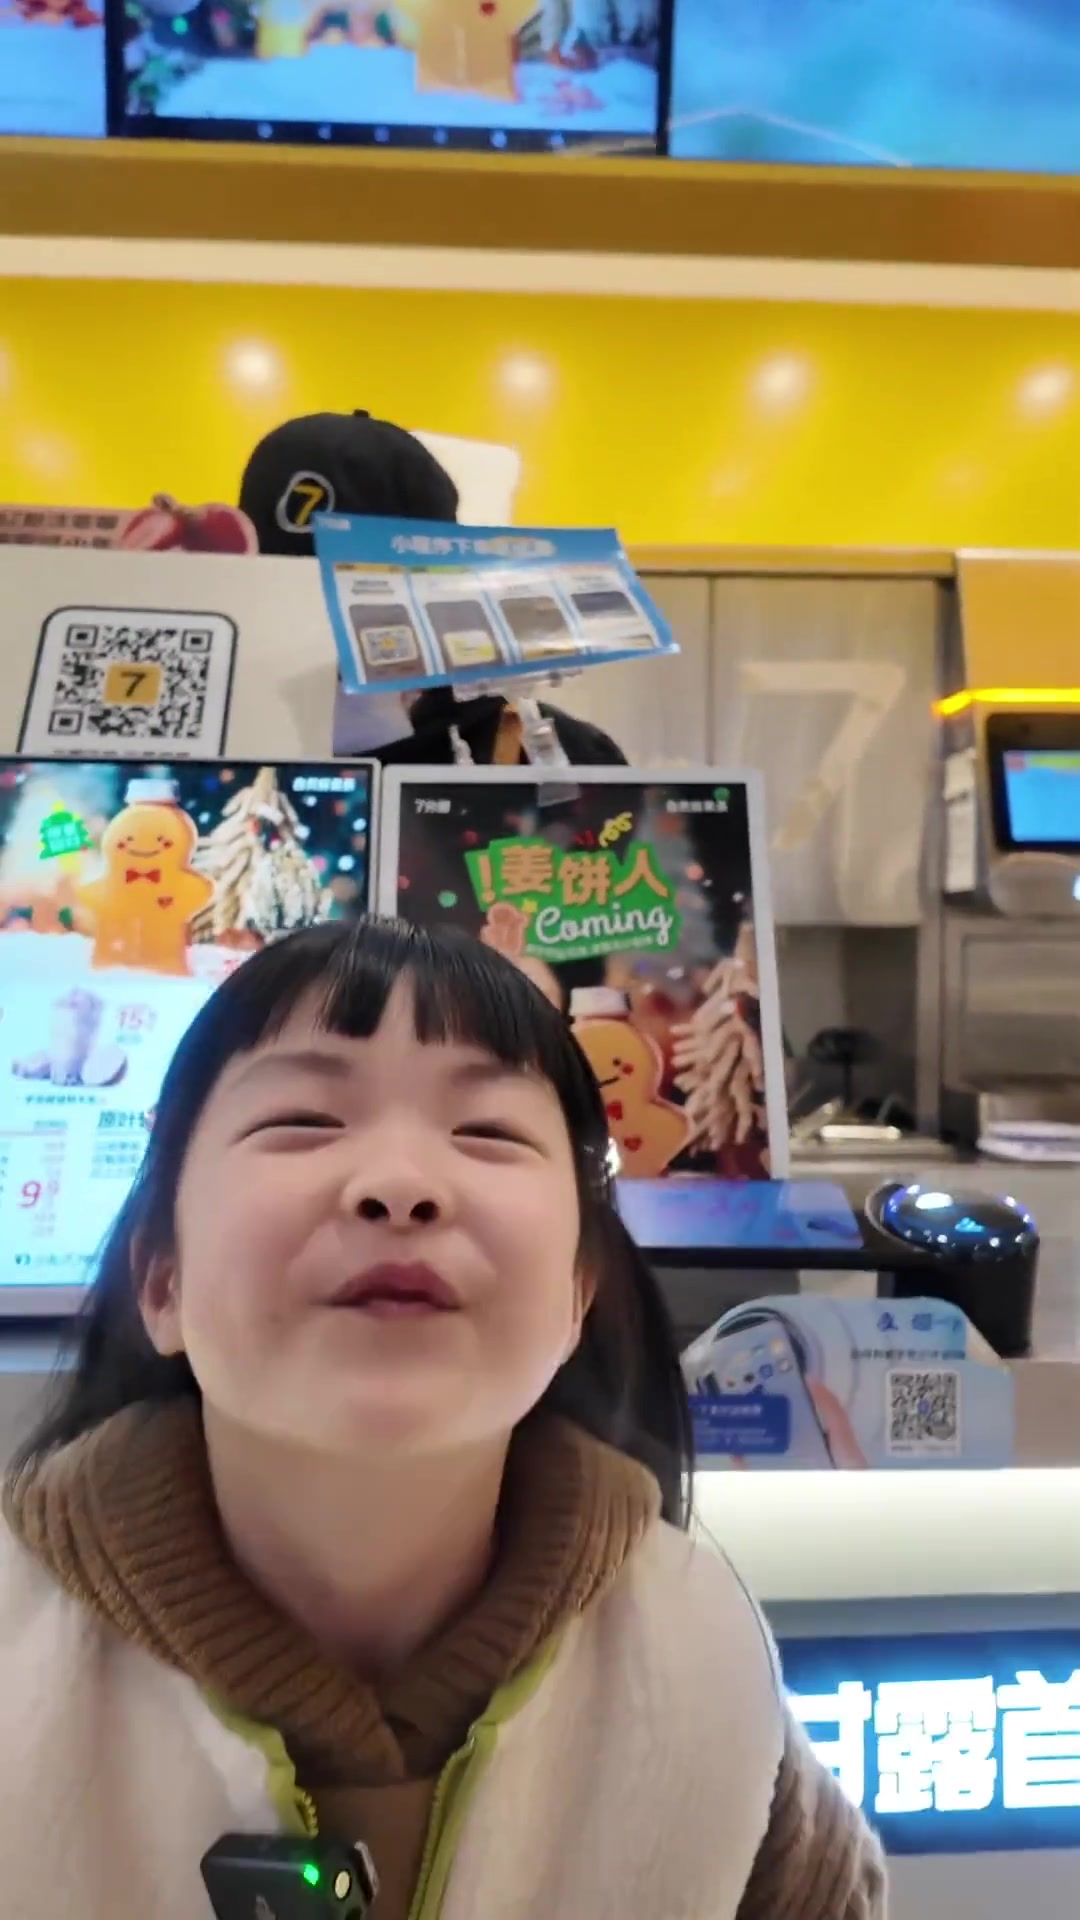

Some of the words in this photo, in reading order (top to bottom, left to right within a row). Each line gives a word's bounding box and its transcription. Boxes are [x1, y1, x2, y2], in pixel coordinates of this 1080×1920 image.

[290, 484, 324, 526] 7
[119, 671, 147, 698] 7
[535, 902, 673, 947] Coming
[20, 1181, 41, 1208] 9
